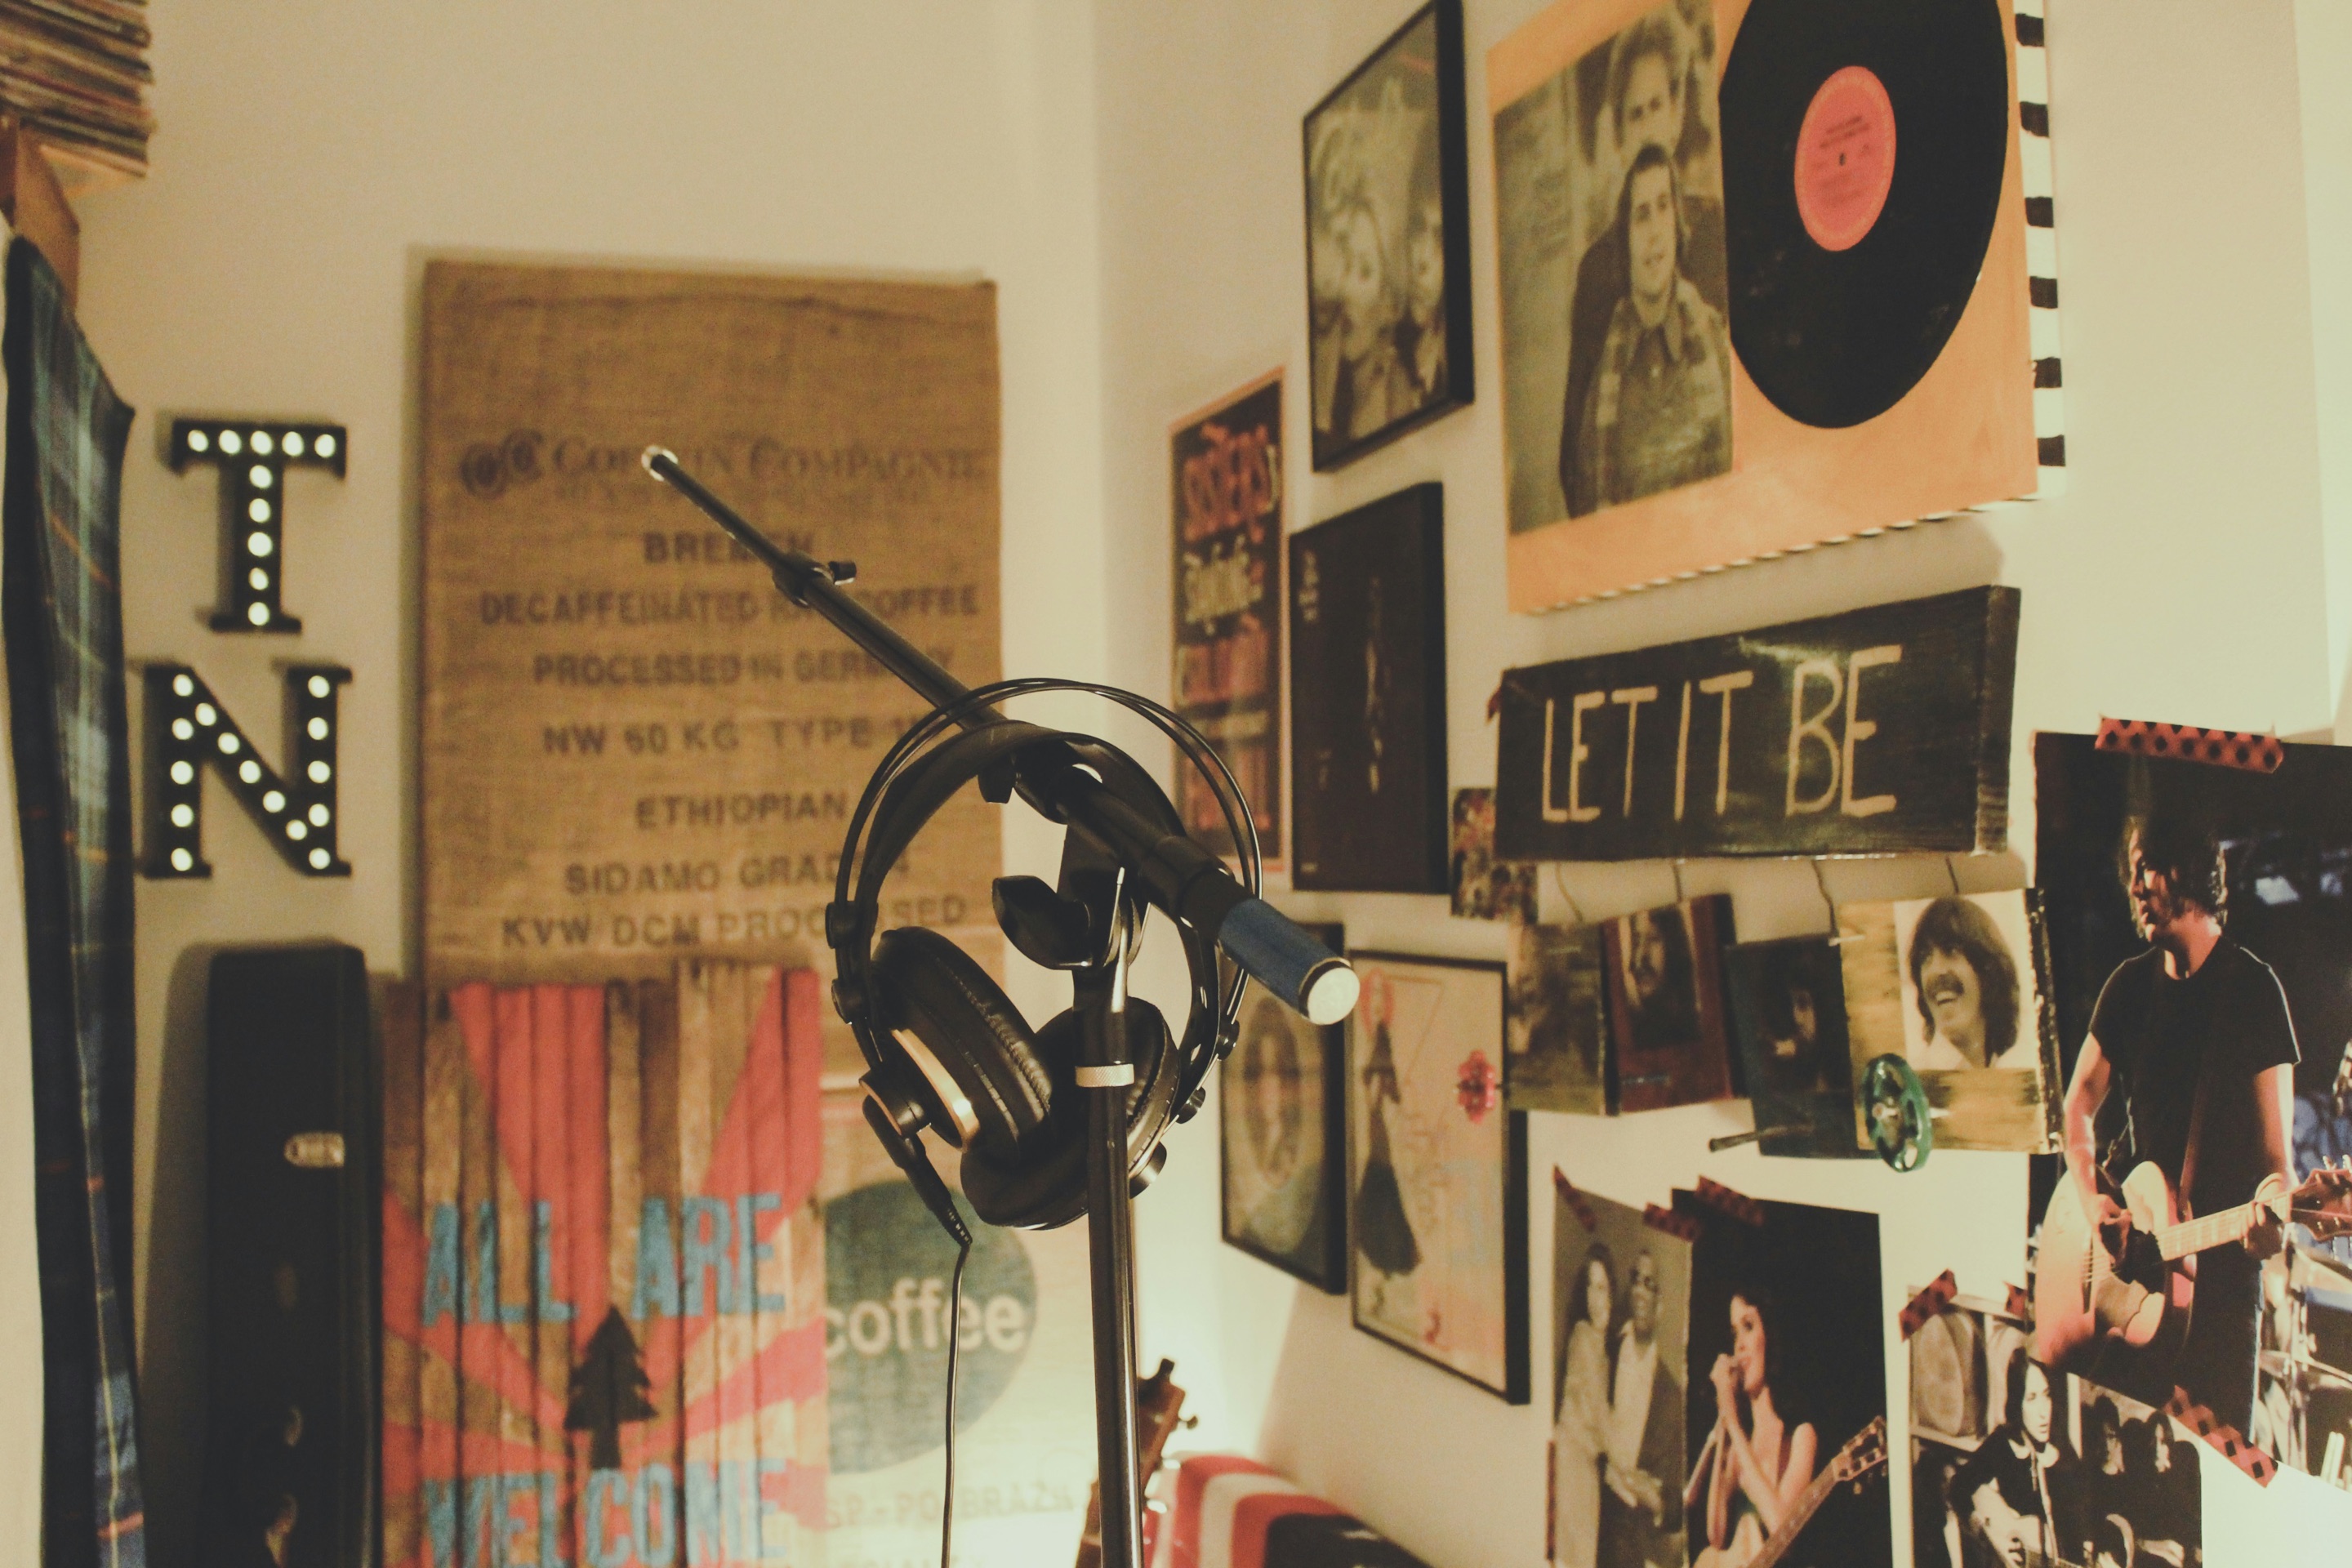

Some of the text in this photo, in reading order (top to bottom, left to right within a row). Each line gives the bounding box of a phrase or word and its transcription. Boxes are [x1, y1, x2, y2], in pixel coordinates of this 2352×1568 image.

[172, 418, 348, 634] T
[644, 530, 813, 564] BREMN
[532, 653, 741, 687] PROCESSED
[794, 648, 954, 683] GERMY
[541, 724, 606, 756] NW
[684, 721, 740, 752] KG
[772, 716, 872, 750] TYPE
[1542, 644, 1904, 824] LET IT BE
[142, 663, 353, 880] N
[634, 790, 849, 831] ETHIOPIAN
[564, 860, 722, 894] SIDAMO
[501, 894, 969, 947] KVW DCM PROCSED
[422, 1191, 786, 1327] ALL ARE
[826, 1276, 1025, 1361] coffee
[422, 1457, 787, 1568] WELCOME
